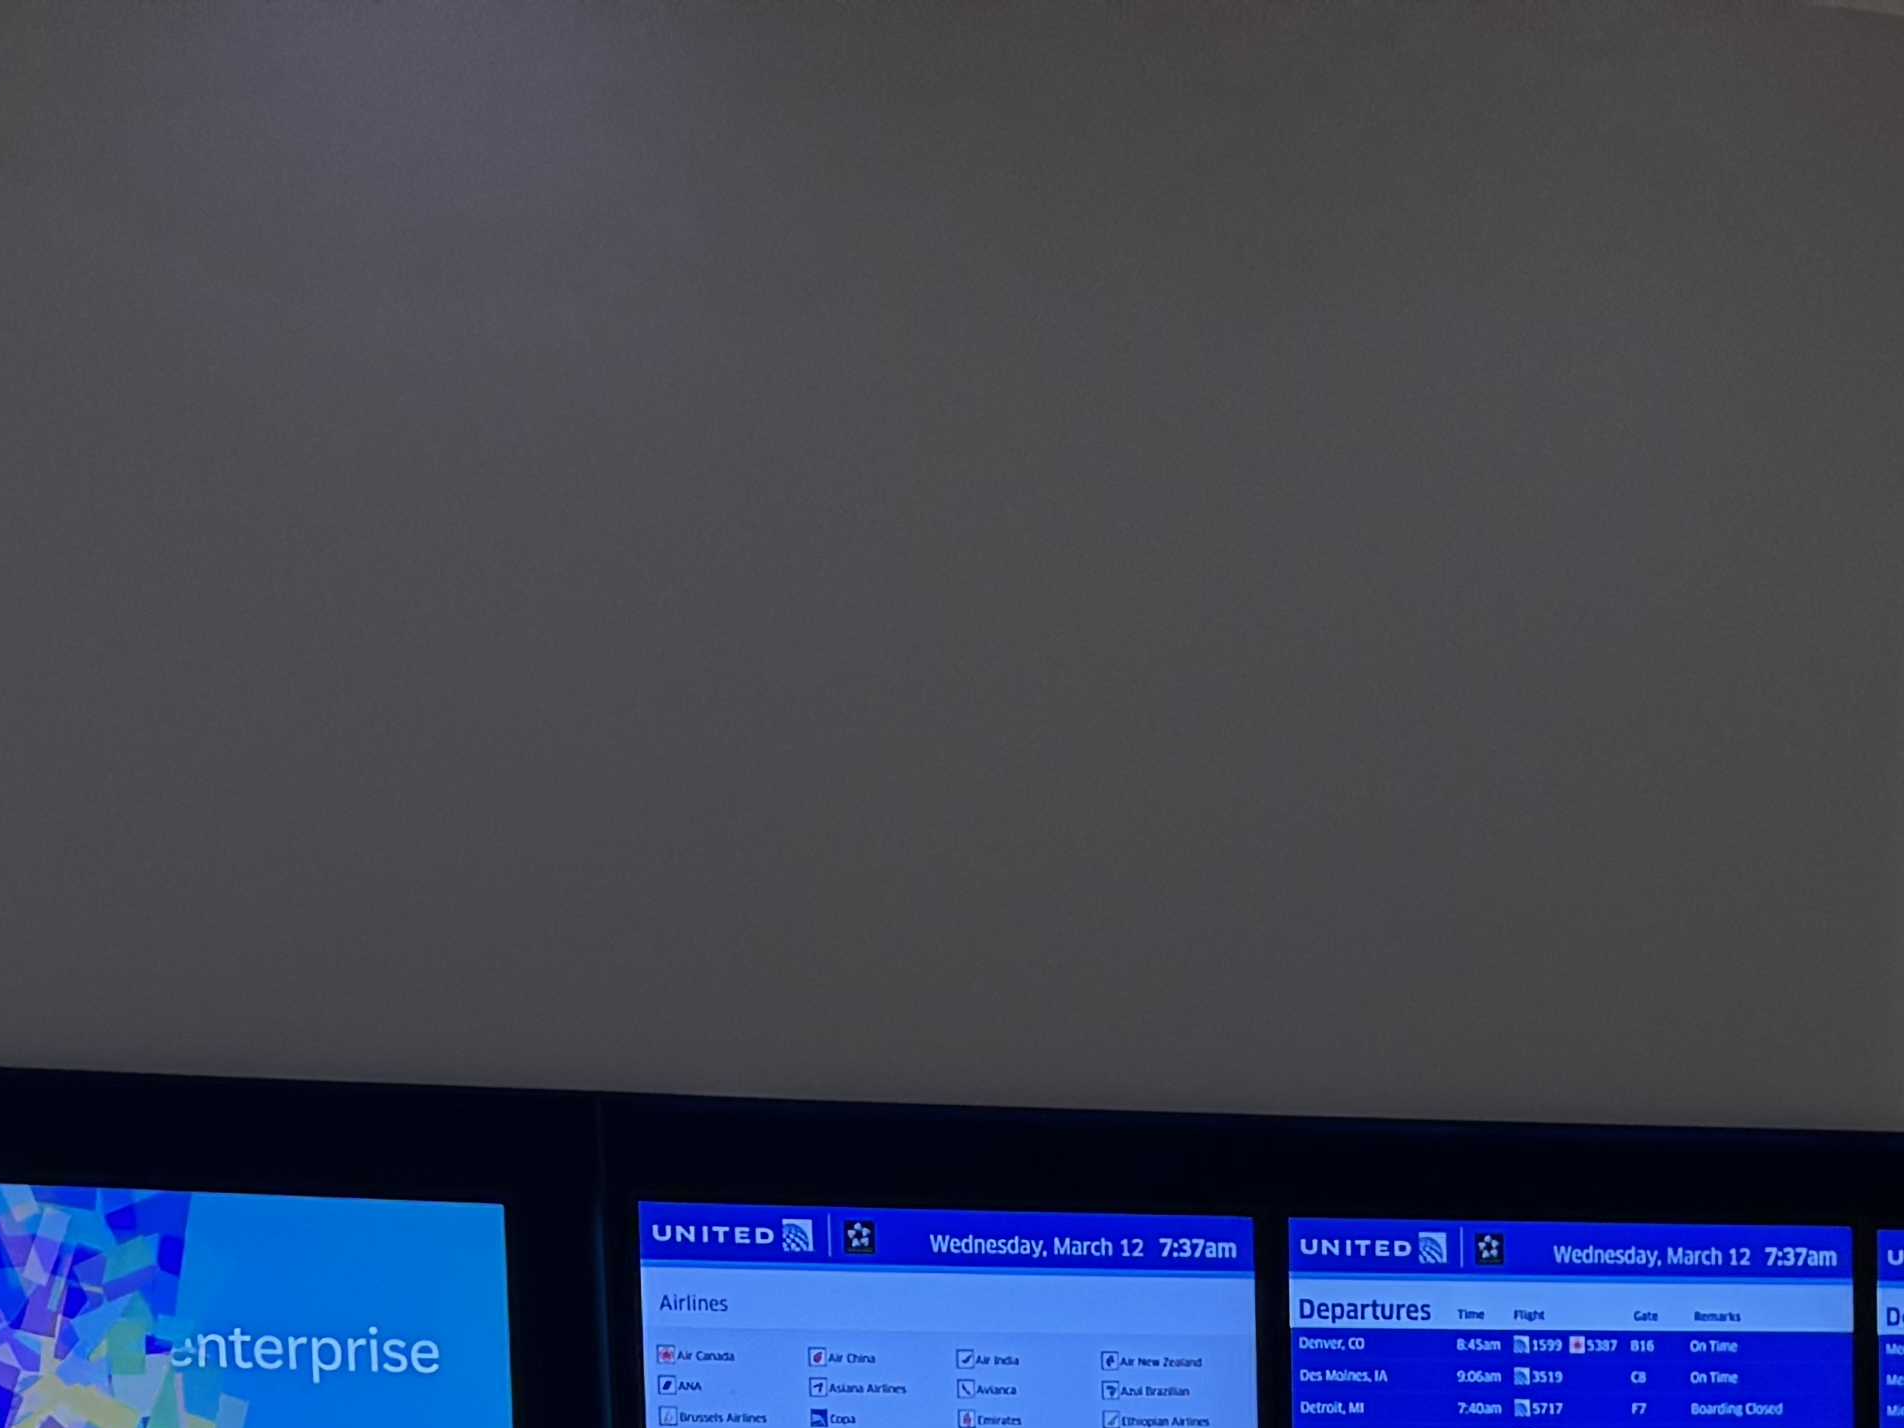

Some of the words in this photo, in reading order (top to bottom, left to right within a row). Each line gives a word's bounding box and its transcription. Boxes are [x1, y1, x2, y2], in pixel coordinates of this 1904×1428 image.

[651, 1224, 775, 1244] UNITED
[929, 1233, 1048, 1258] Wednesday,
[1053, 1236, 1113, 1257] March
[1120, 1238, 1144, 1257] 12
[1158, 1237, 1237, 1259] 7:37am
[1299, 1238, 1412, 1257] UNITED
[1552, 1244, 1662, 1268] Wednesday,
[1666, 1246, 1723, 1266] March
[1728, 1247, 1751, 1266] 12
[1764, 1246, 1837, 1267] 7:37am
[659, 1293, 729, 1312] Airlines
[1298, 1298, 1431, 1324] Departures
[1456, 1308, 1485, 1320] Time
[1513, 1309, 1545, 1322] Flight
[1632, 1310, 1659, 1322] Gate
[1693, 1310, 1742, 1322] Remarks
[1299, 1401, 1346, 1415] Detroit,
[1348, 1401, 1365, 1414] MI
[1457, 1401, 1502, 1415] 7:40am
[1532, 1401, 1563, 1415] 5717
[1630, 1402, 1647, 1414] F7
[1690, 1402, 1743, 1418] Boarding
[1744, 1402, 1783, 1415] Closed
